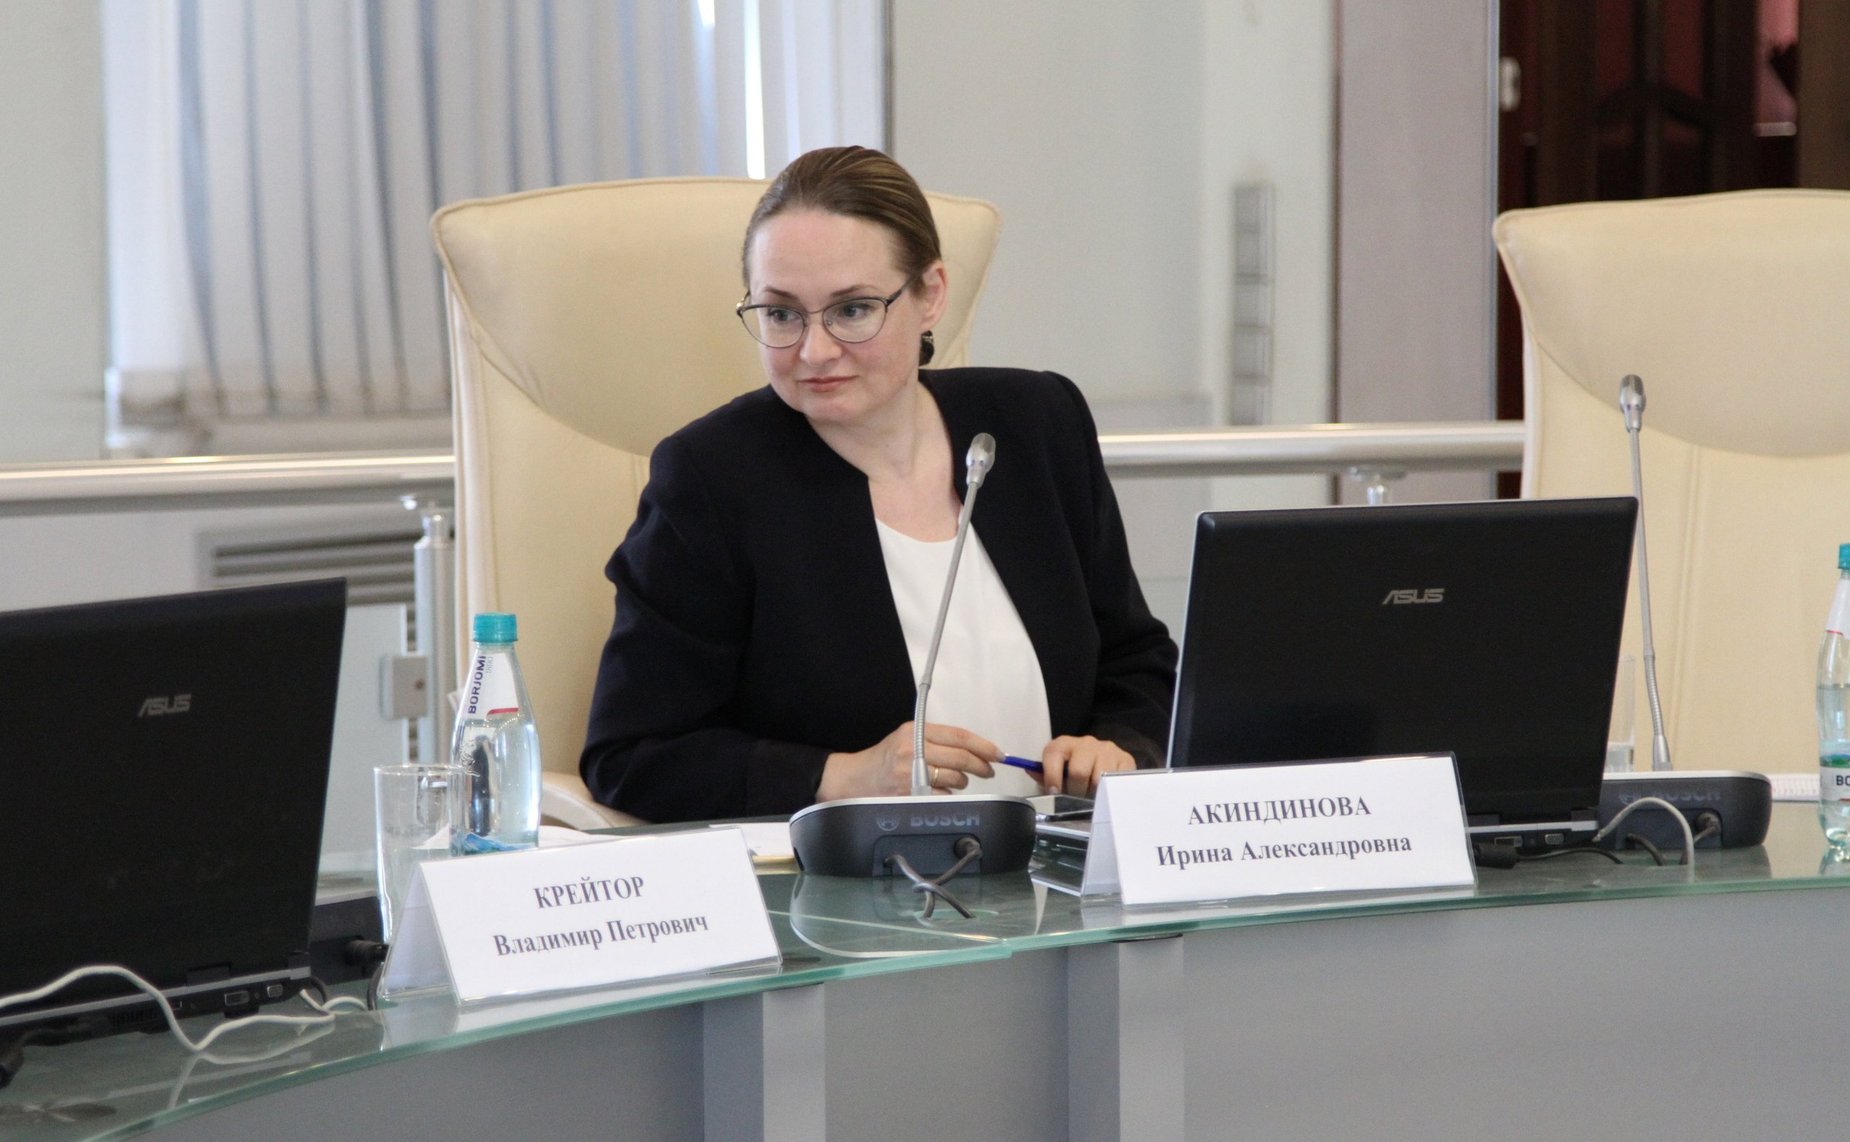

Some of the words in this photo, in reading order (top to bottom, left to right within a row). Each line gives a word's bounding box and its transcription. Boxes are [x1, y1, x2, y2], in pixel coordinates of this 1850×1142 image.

[1382, 588, 1445, 605] ASUS
[468, 655, 486, 714] BORJOMI
[138, 694, 191, 717] ASUS
[910, 813, 980, 827] BOSCH
[1188, 796, 1372, 825] АКИНДИНОВА
[1156, 845, 1233, 870] Ирина
[1240, 836, 1412, 860] Александровна
[533, 876, 645, 909] КРЕЙТОР
[492, 928, 603, 956] Владимир
[606, 915, 709, 943] Петрович
